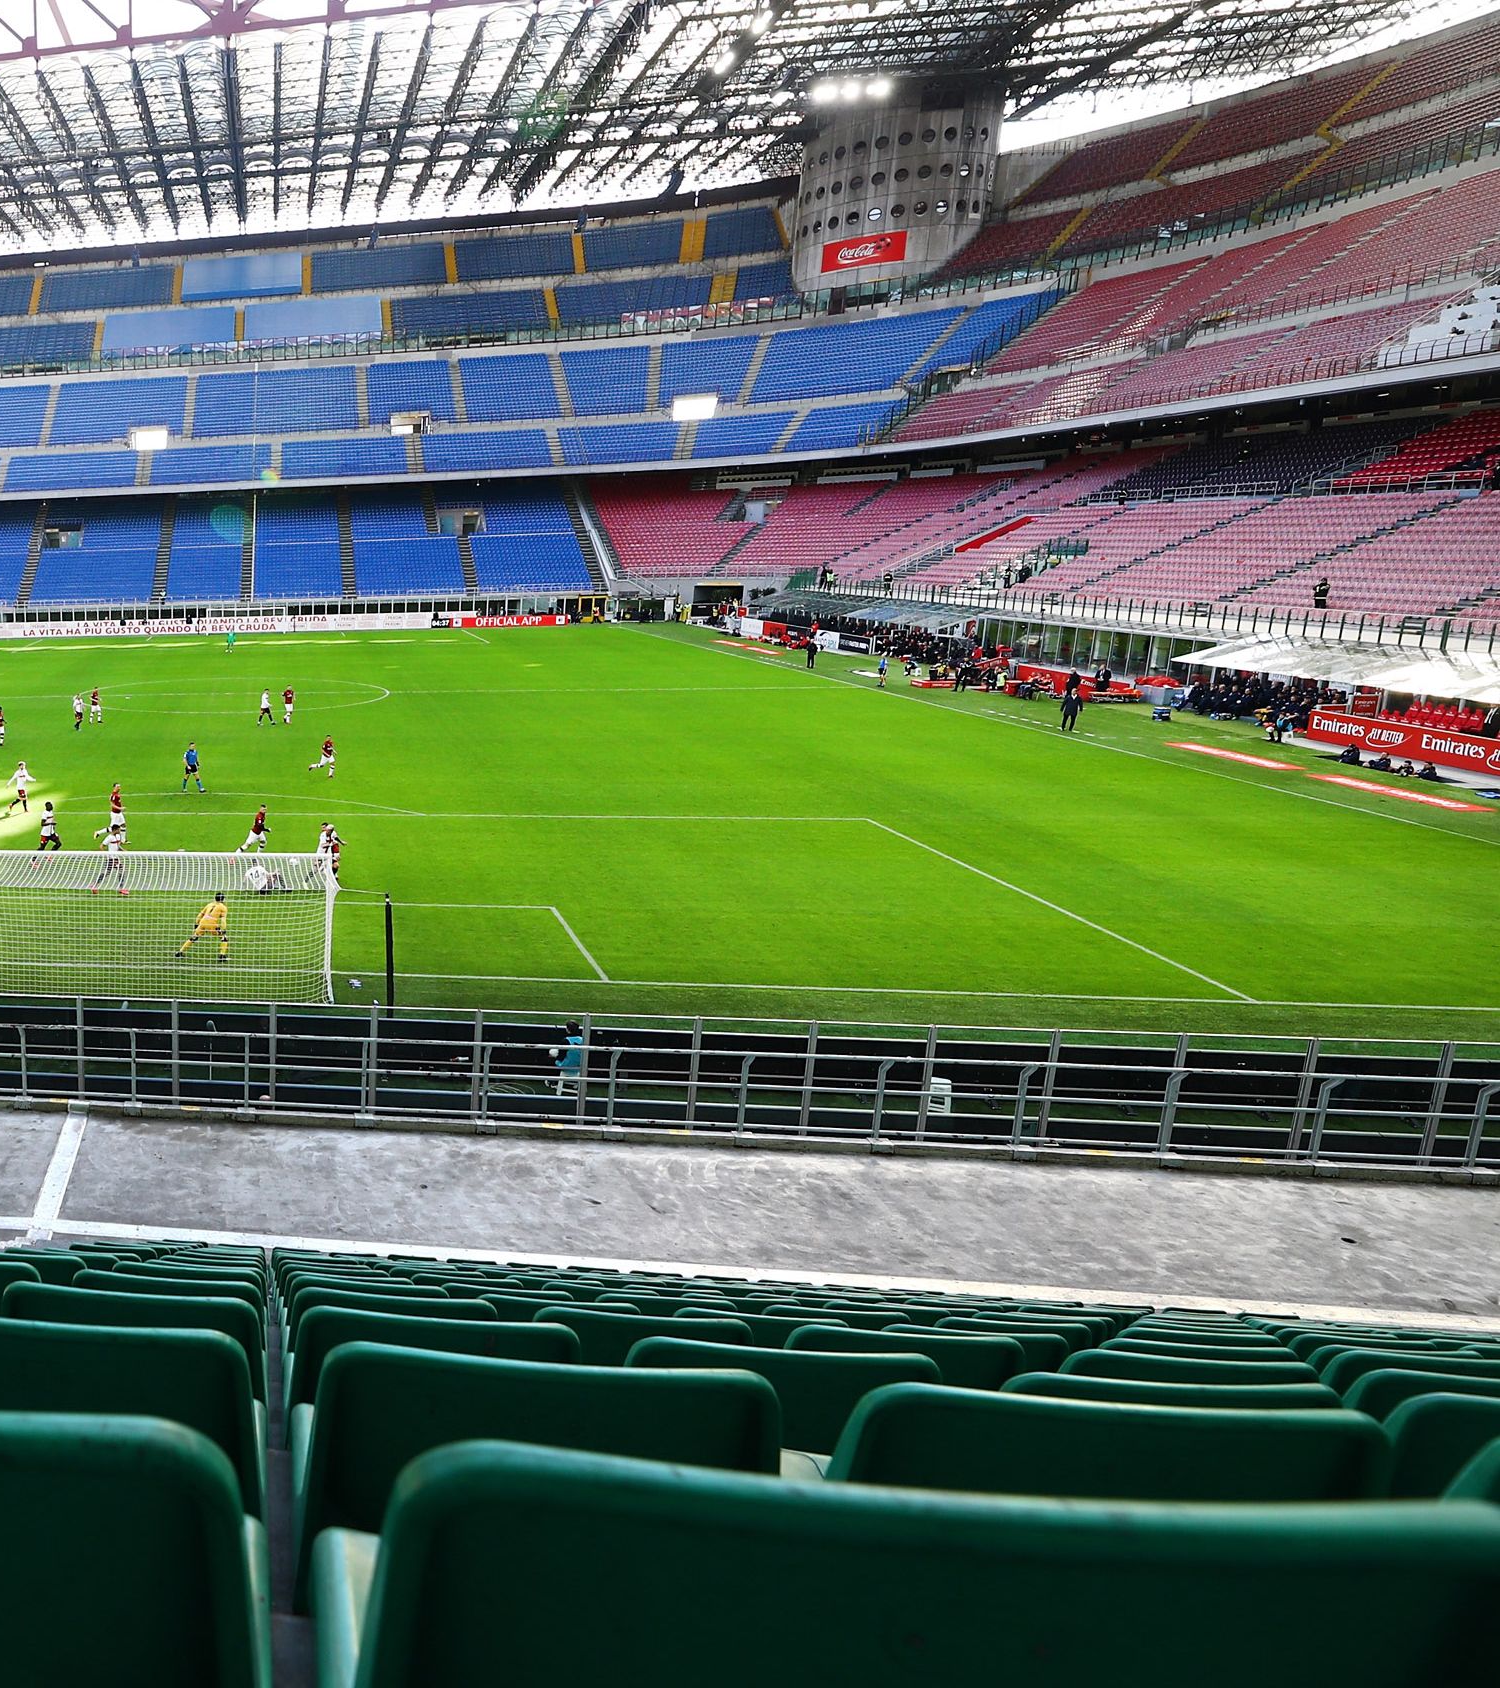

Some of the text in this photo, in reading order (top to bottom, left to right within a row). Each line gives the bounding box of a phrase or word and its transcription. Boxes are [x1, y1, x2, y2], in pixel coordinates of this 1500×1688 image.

[432, 619, 449, 627] 04:37
[476, 616, 542, 626] OFFICIAL APP
[38, 628, 62, 636] VITA
[66, 627, 81, 635] HA
[106, 626, 140, 634] GUSTO
[144, 625, 191, 634] QUANDO
[211, 624, 234, 632] BEVI
[238, 623, 276, 631] CRUDA
[1313, 715, 1404, 744] Emirates FLY BETTER
[1421, 734, 1486, 759] Emirates
[250, 870, 260, 880] 14
